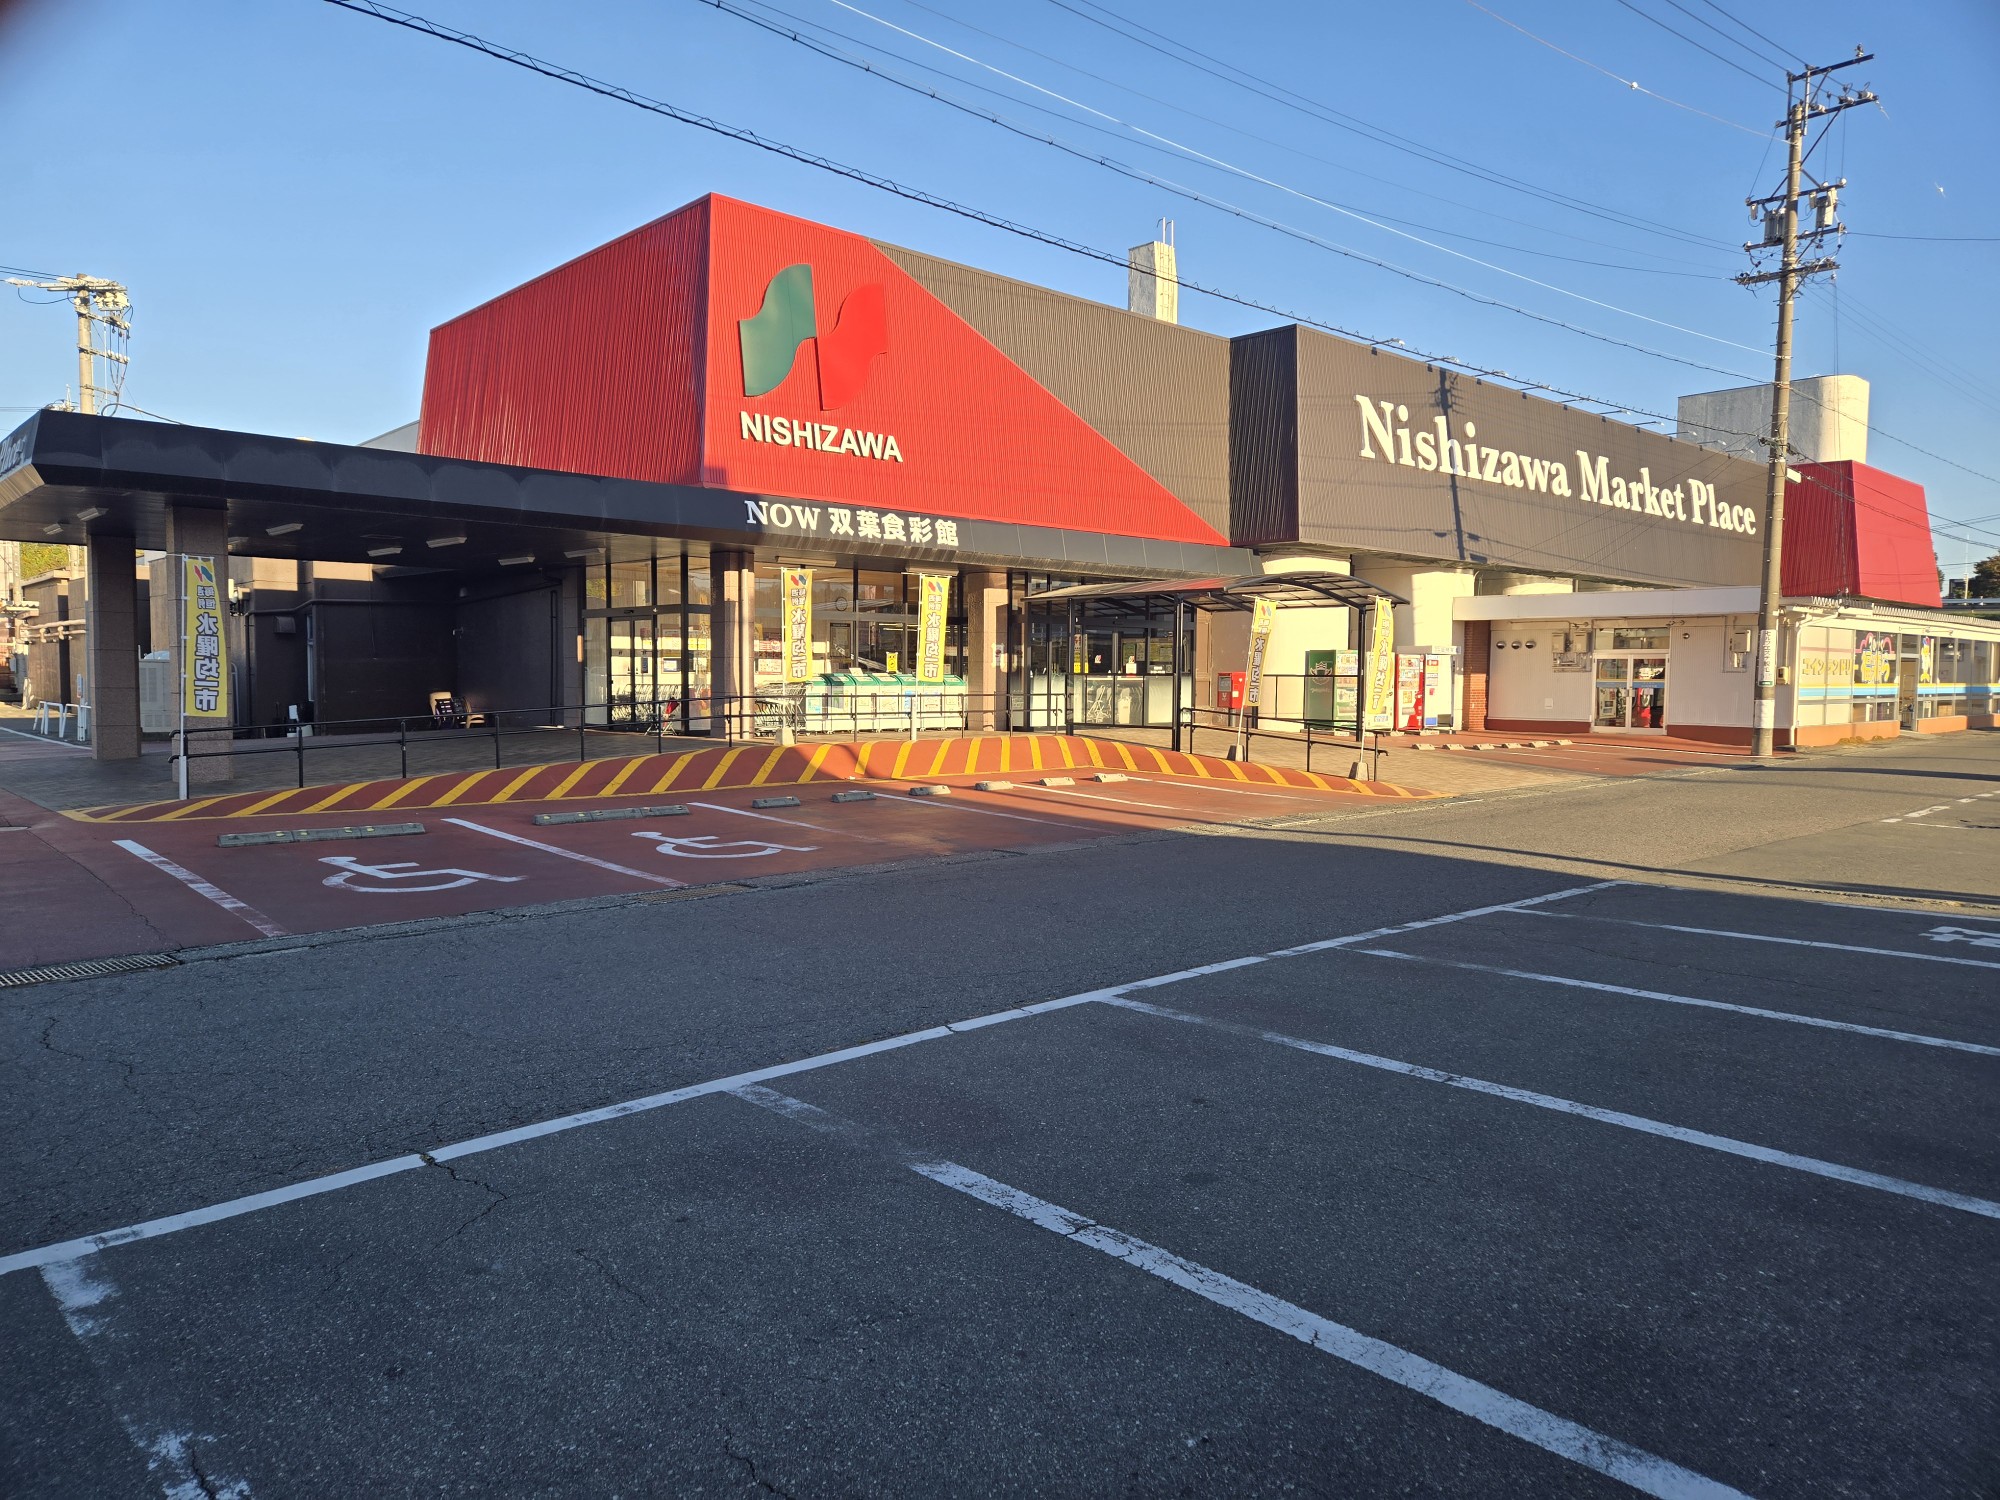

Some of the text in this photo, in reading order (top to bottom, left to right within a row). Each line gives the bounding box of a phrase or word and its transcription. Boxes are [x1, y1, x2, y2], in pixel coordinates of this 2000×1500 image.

[740, 411, 904, 463] NISHIZAWA
[1354, 394, 1757, 535] Nishizawa Market Place
[744, 500, 959, 547] NOW 双葉食彩館
